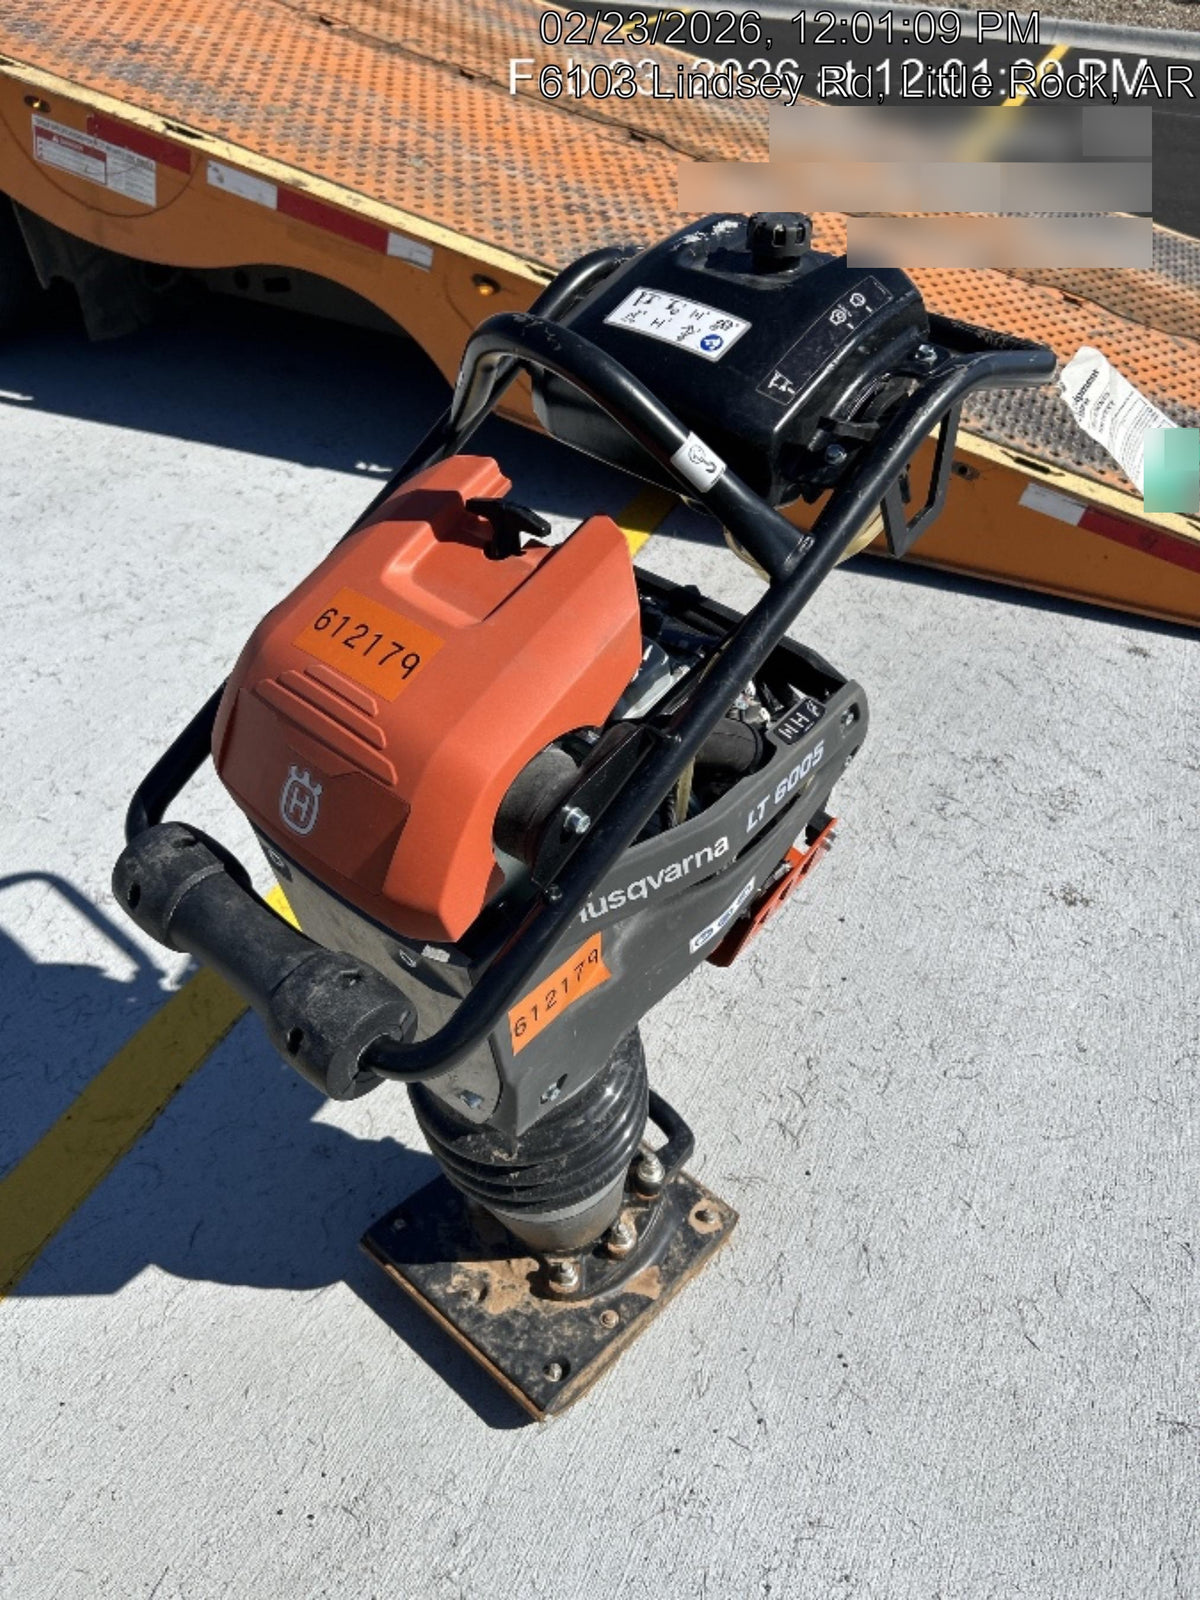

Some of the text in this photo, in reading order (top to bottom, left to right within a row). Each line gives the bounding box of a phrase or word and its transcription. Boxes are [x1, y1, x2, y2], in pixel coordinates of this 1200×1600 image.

[313, 607, 421, 681] 612179
[745, 739, 825, 834] LT 6005
[513, 948, 599, 1038] 612179
